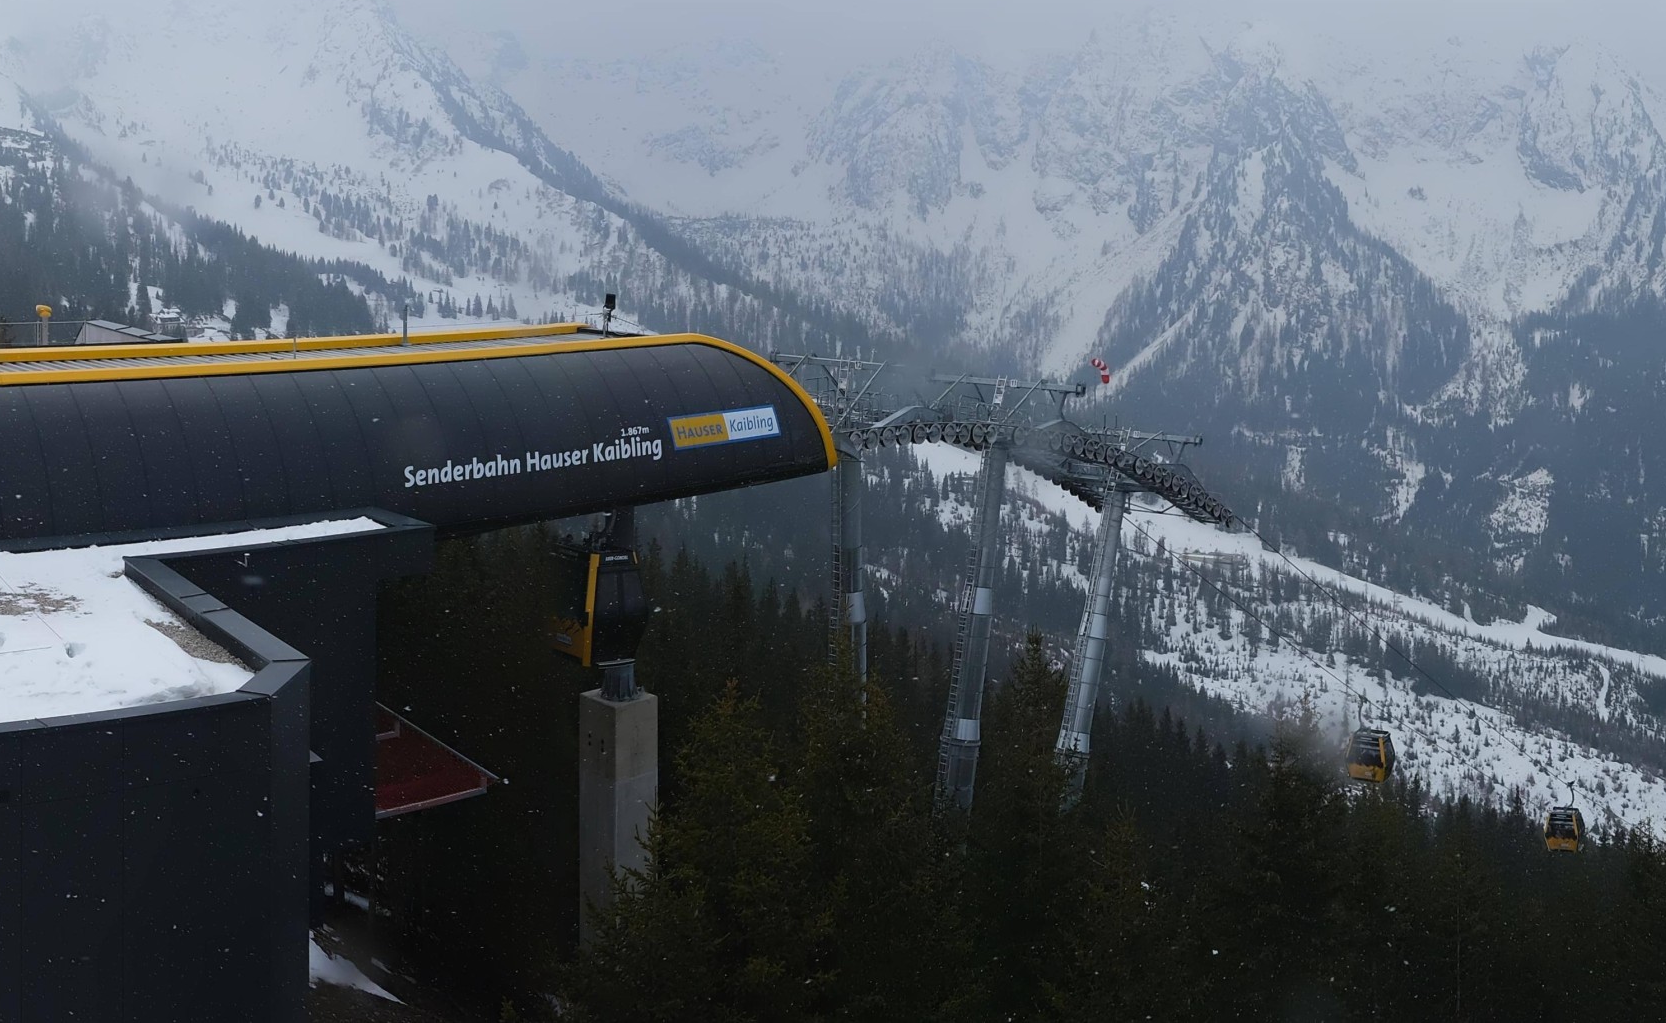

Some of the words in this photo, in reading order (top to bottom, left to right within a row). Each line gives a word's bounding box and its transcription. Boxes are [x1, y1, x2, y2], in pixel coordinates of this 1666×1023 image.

[621, 426, 649, 437] 1.867m
[730, 415, 774, 433] Kaibling
[404, 454, 521, 488] Senderbahn
[526, 449, 588, 472] Hauser
[593, 437, 662, 462] Kaibling
